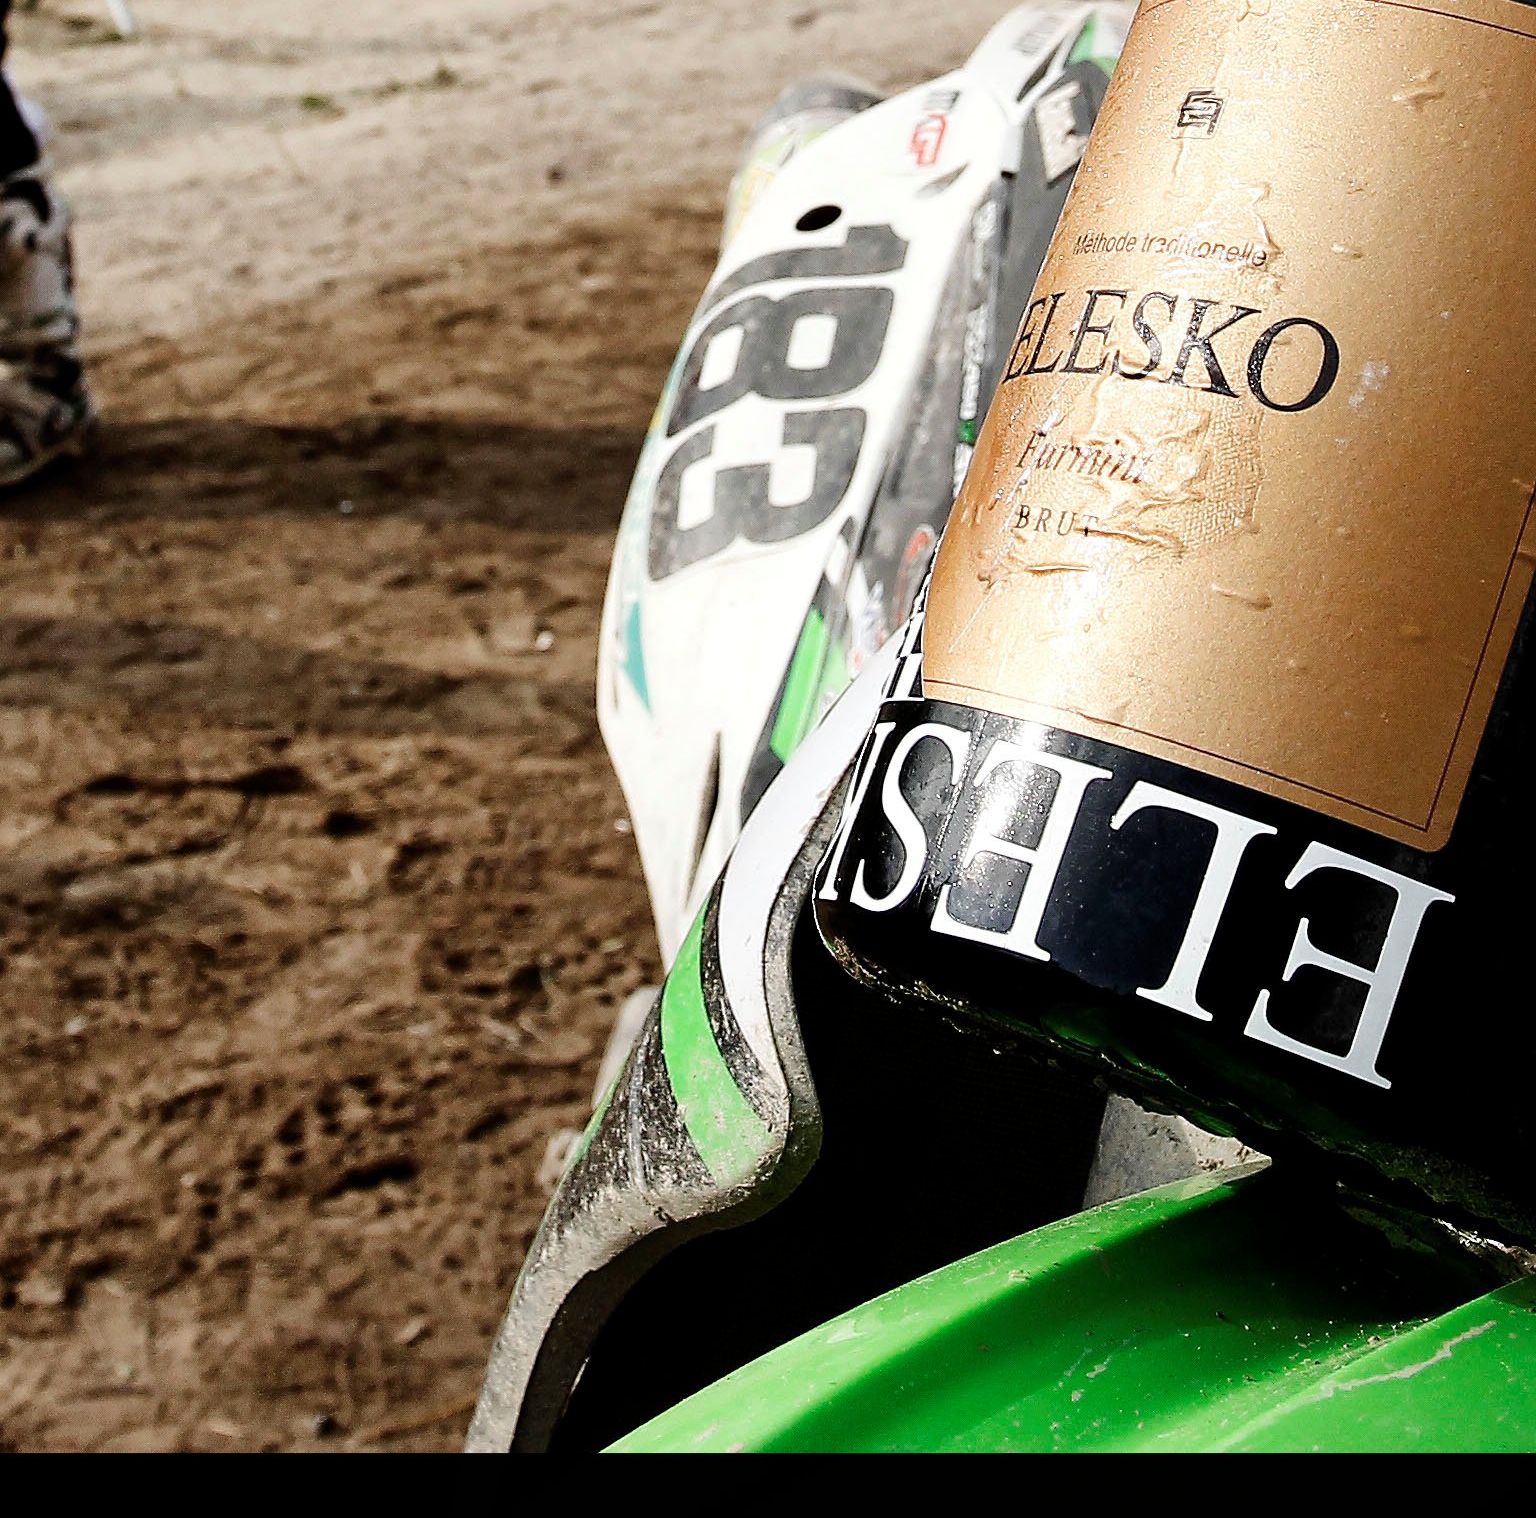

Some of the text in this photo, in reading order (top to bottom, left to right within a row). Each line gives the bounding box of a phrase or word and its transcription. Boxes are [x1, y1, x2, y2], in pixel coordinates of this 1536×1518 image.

[647, 223, 909, 582] 183
[1003, 288, 1341, 413] ELESKO
[1015, 504, 1099, 537] BRUT
